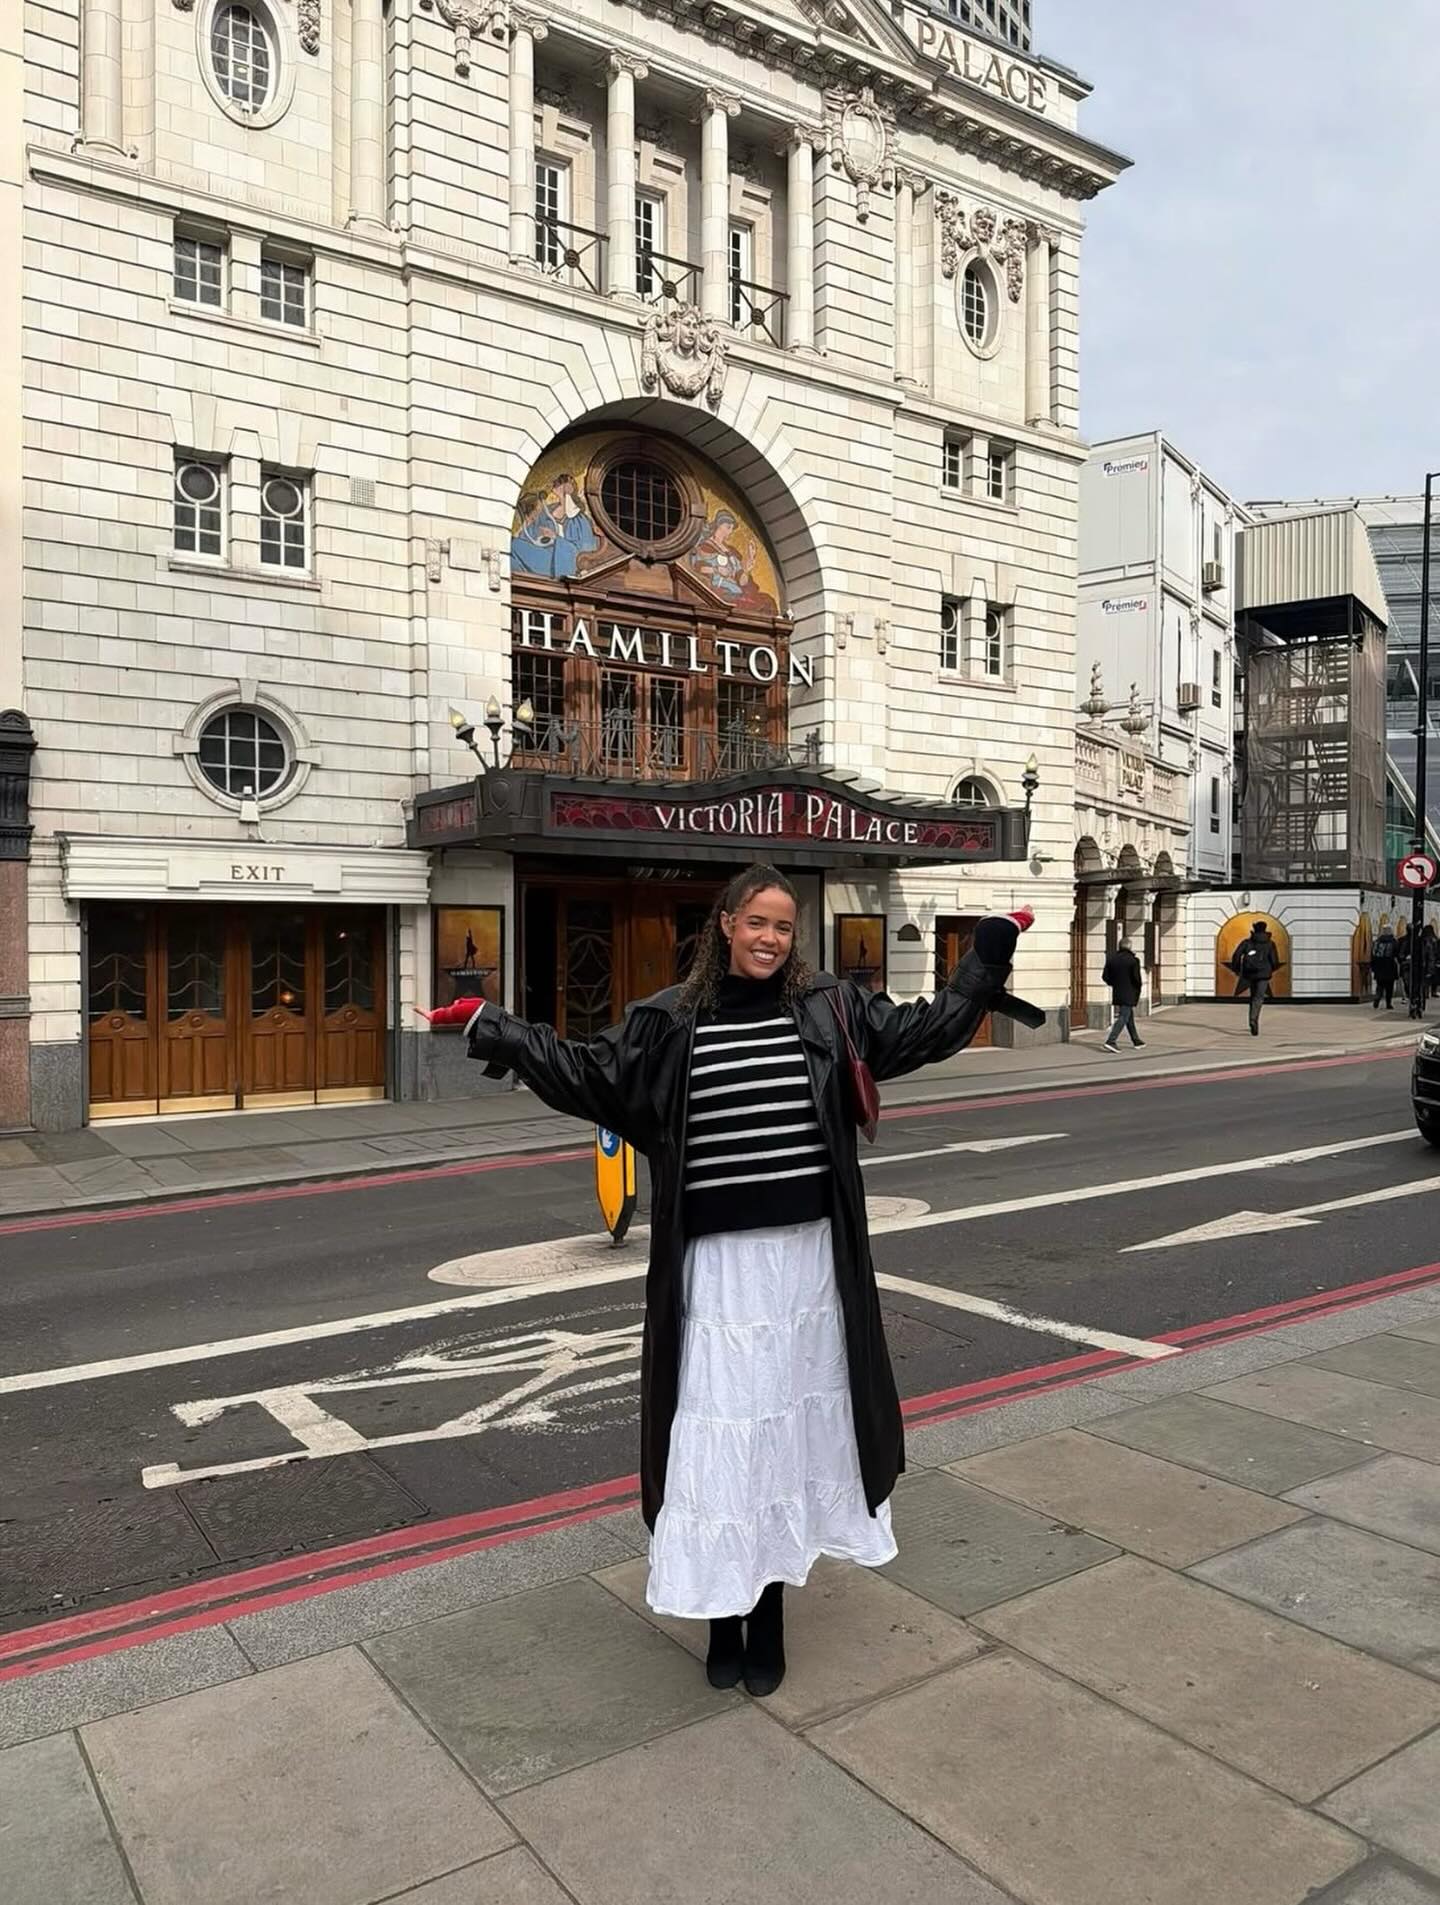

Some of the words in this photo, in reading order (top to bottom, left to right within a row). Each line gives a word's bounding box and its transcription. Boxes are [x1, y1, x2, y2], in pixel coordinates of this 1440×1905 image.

[915, 17, 1048, 115] PALACE
[1104, 460, 1146, 473] Premier
[1103, 600, 1145, 611] Premier
[517, 608, 815, 689] HAMILTON
[653, 792, 784, 835] VICTORIA
[806, 793, 919, 844] PALACE
[231, 864, 286, 881] EXIT
